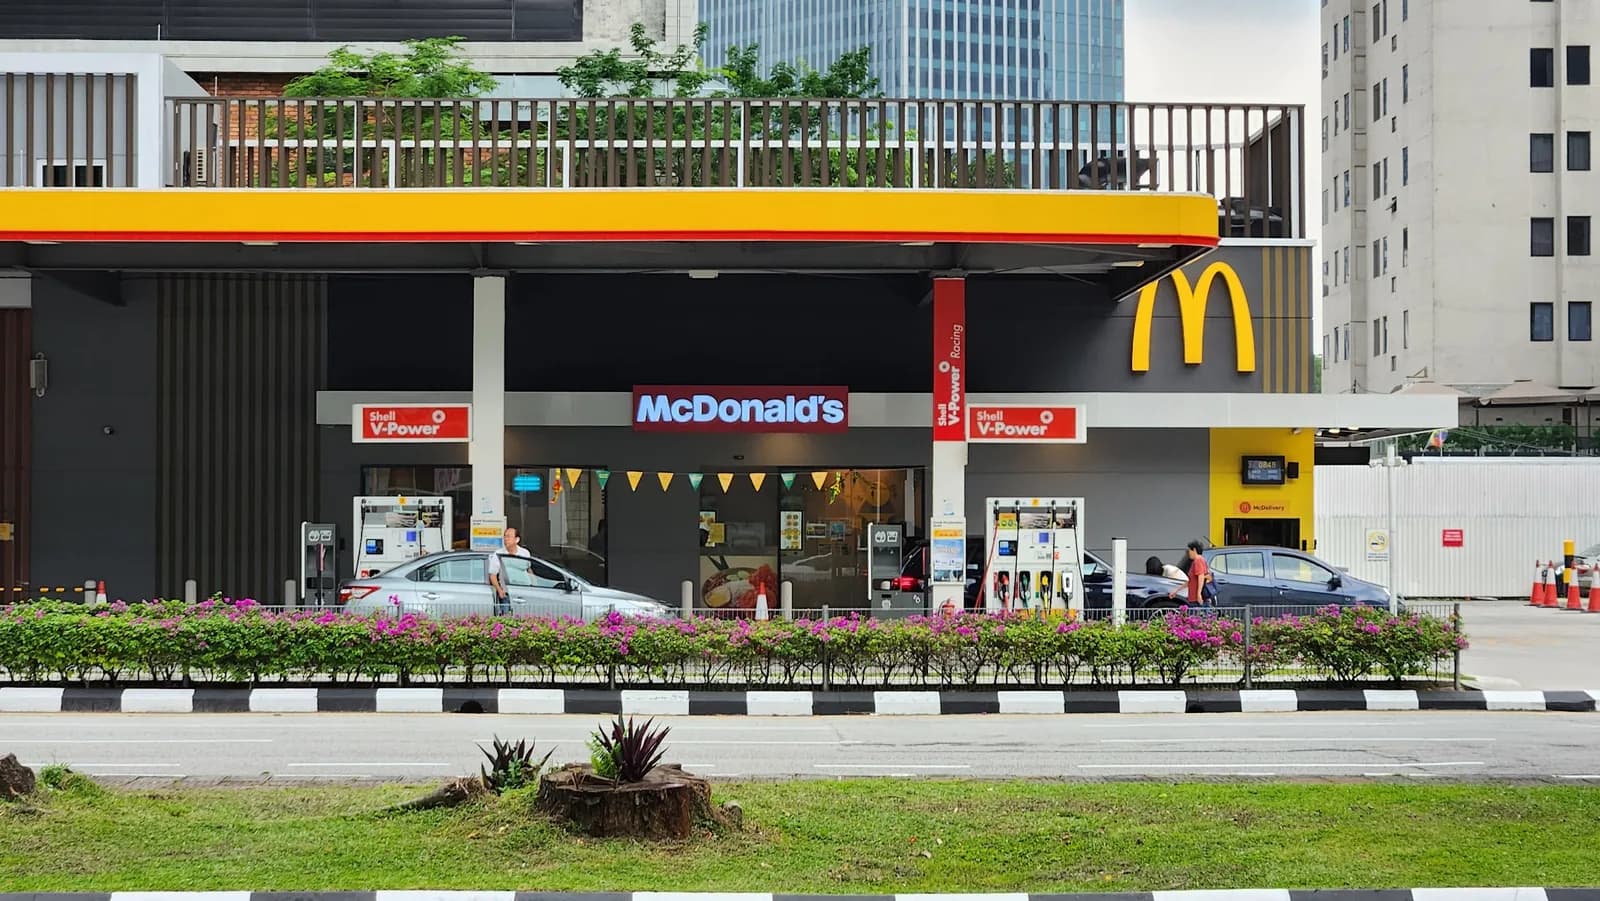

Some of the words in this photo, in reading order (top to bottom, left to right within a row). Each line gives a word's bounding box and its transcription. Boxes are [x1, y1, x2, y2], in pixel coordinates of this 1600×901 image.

[951, 324, 963, 358] Racing
[948, 366, 961, 426] V-Power
[369, 410, 396, 421] Shell
[636, 395, 844, 423] McDonald's
[938, 404, 947, 426] Shell
[976, 410, 1004, 421] Shell
[370, 421, 440, 435] V-Power
[977, 421, 1048, 435] V-Power
